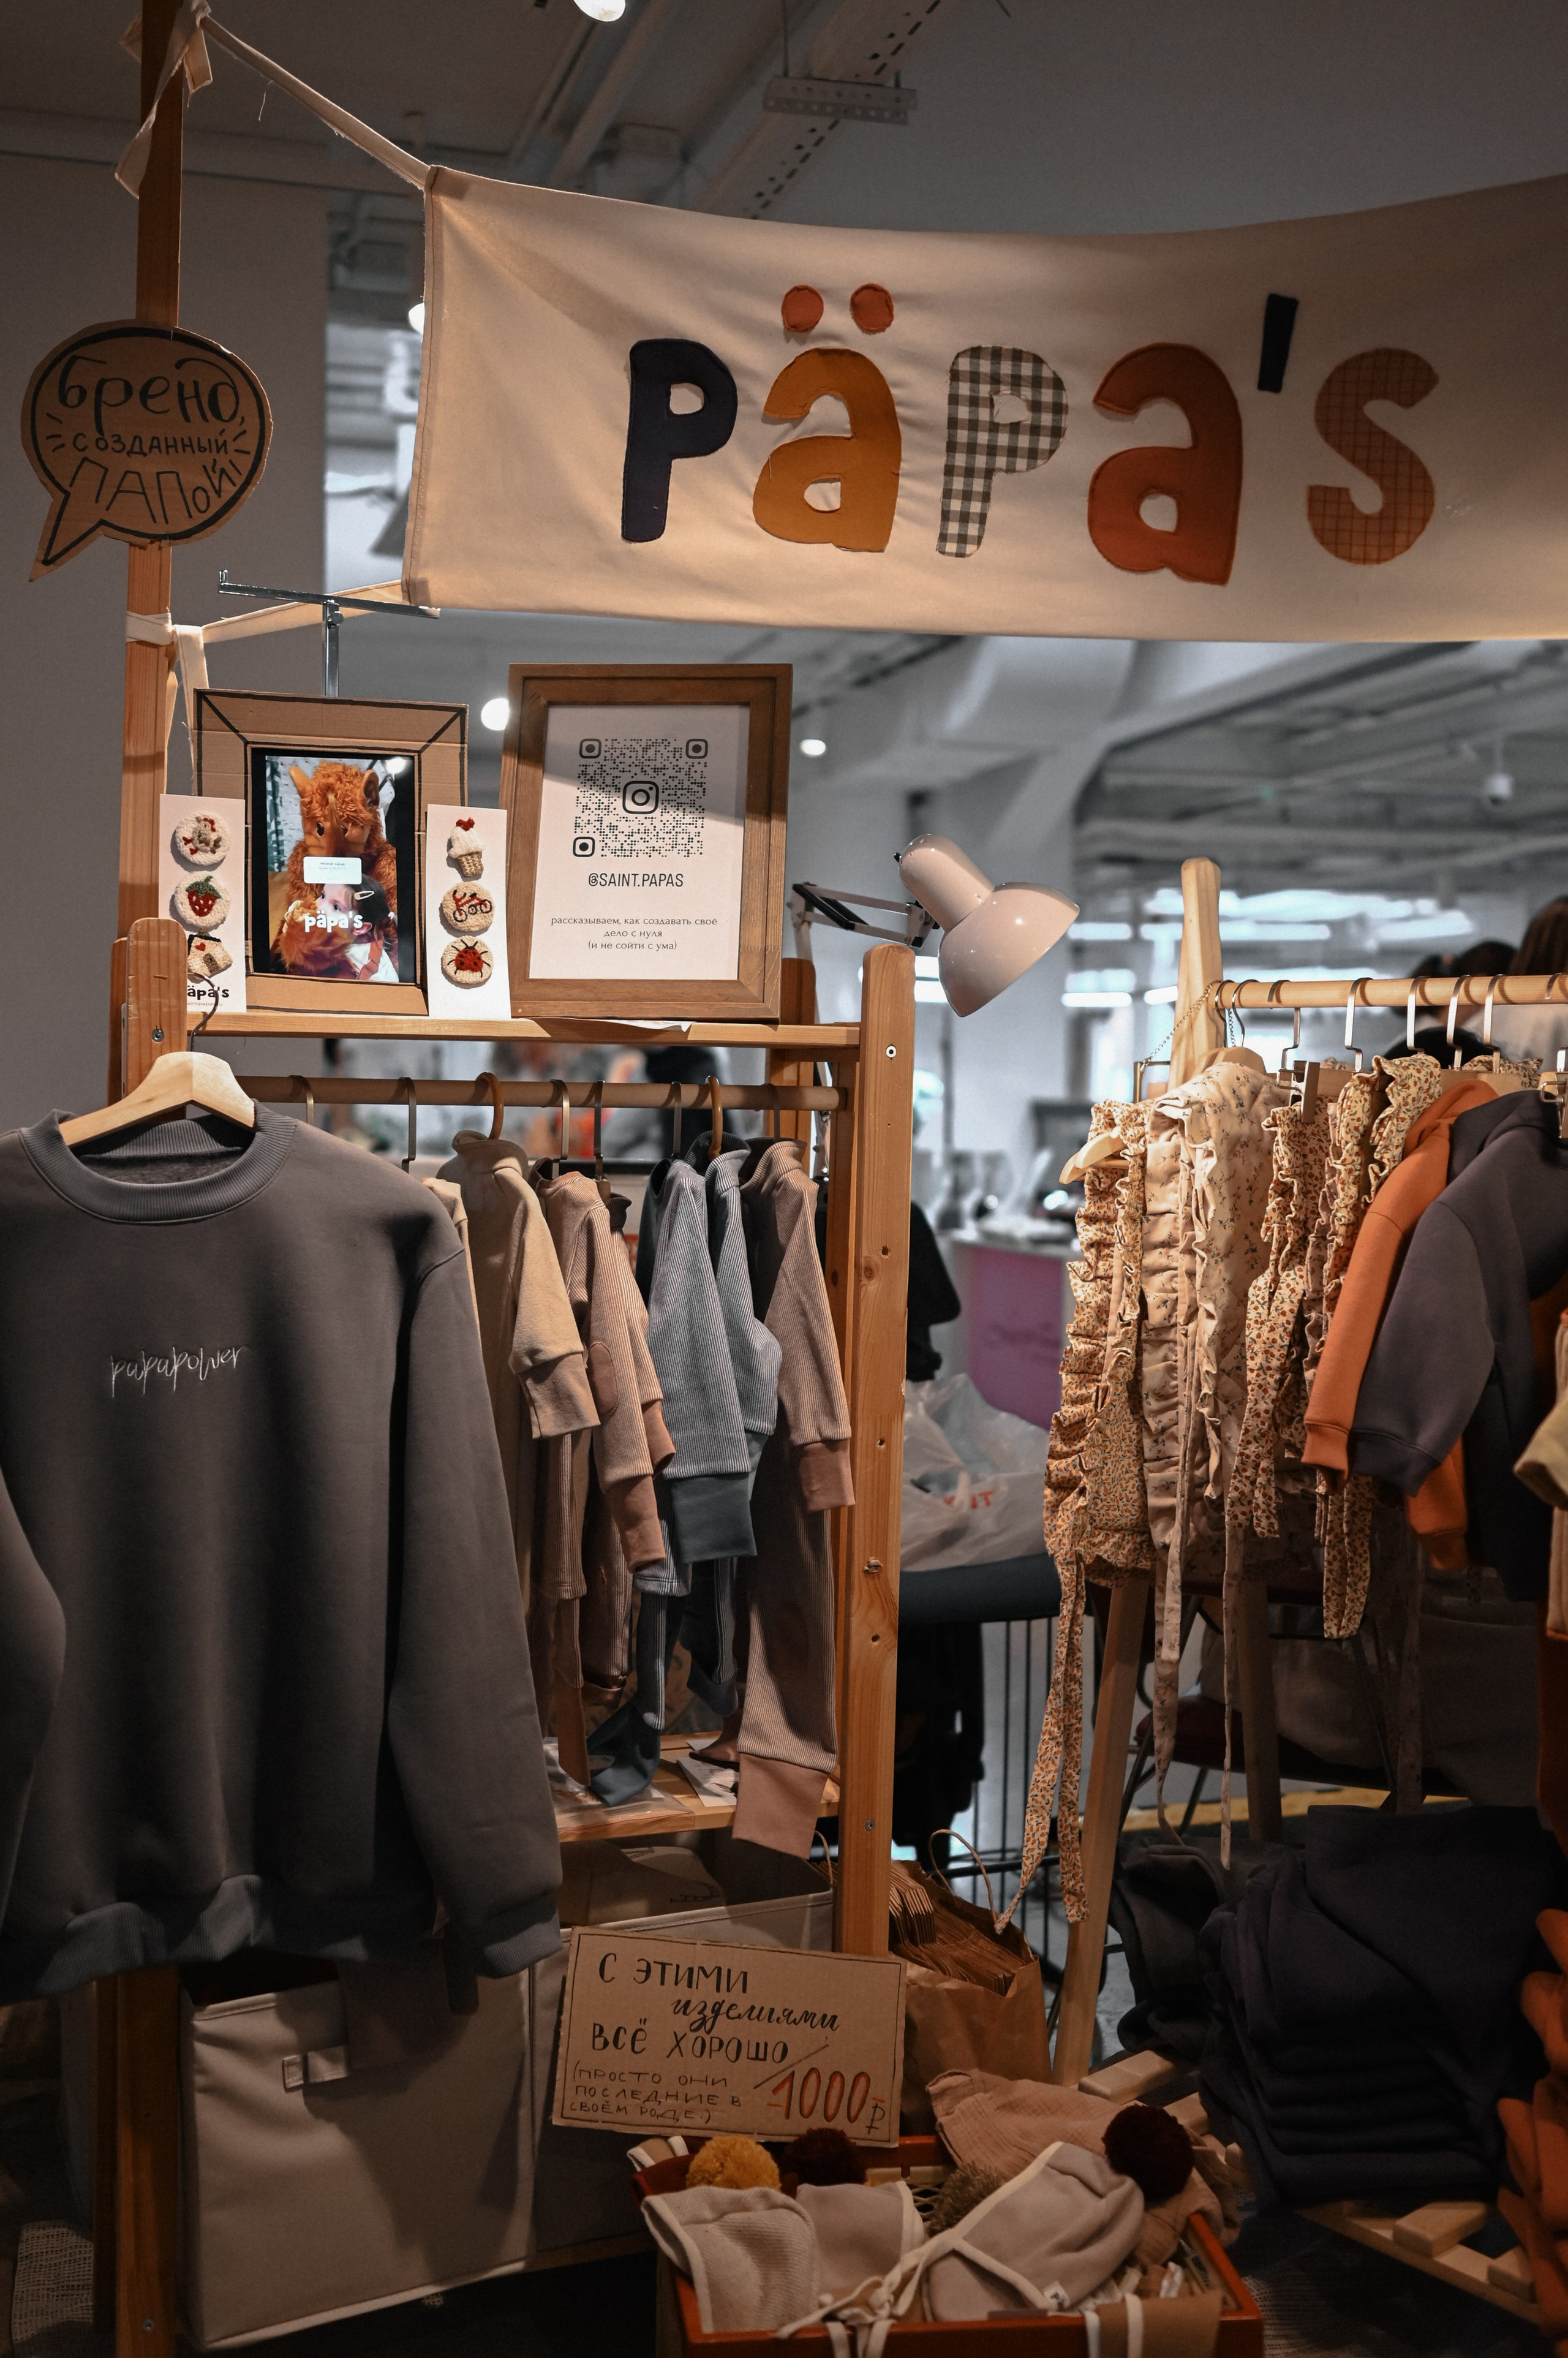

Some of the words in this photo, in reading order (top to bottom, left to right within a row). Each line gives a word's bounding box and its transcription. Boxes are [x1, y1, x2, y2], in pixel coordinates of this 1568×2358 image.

[588, 873, 684, 887] @SAINT.PAPAS
[304, 910, 363, 933] päpa's
[588, 940, 597, 949] (и
[656, 941, 677, 951] ума)
[187, 985, 230, 1000] äpa's
[598, 1952, 617, 1983] С
[633, 1958, 748, 1994] ЭТИМИ
[671, 1997, 840, 2035] изделиями
[666, 2030, 789, 2064] ХОРОШО
[573, 2060, 662, 2084] (ПРОСТО
[678, 2074, 728, 2087] ОНИ
[575, 2085, 720, 2107] ПОСЛЕДНИЕ
[731, 2096, 742, 2107] В
[570, 2100, 628, 2115] СВОЁМ
